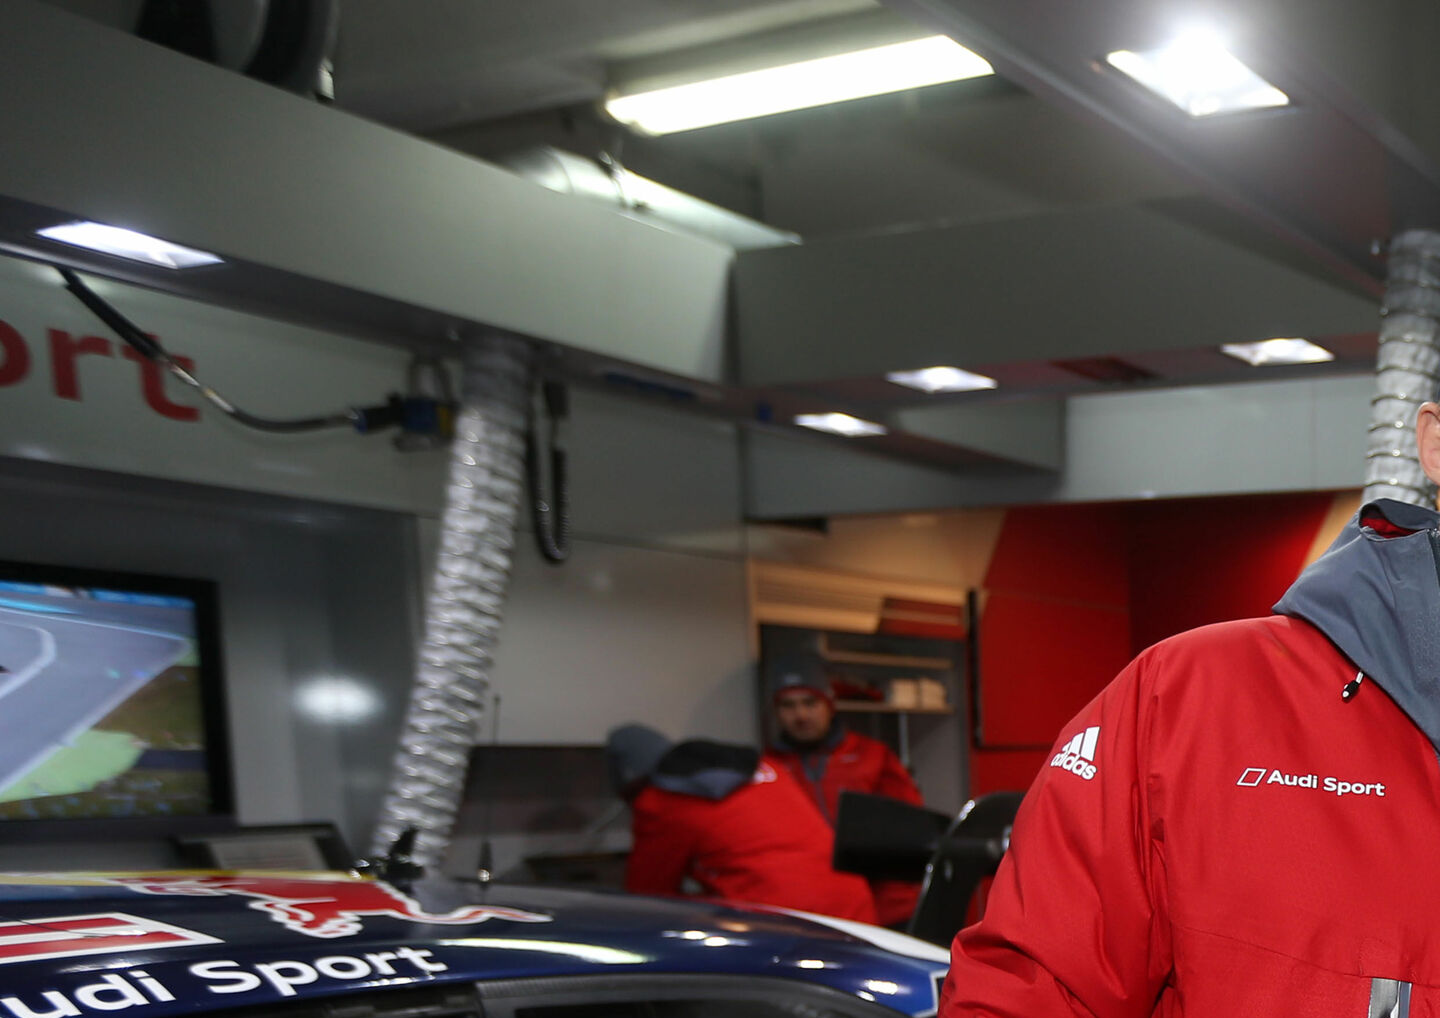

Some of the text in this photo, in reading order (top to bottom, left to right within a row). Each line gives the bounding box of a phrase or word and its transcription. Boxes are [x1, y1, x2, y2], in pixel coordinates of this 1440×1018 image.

[1050, 751, 1097, 780] adidas
[1267, 769, 1386, 796] Audi Sport
[188, 946, 449, 997] Sport
